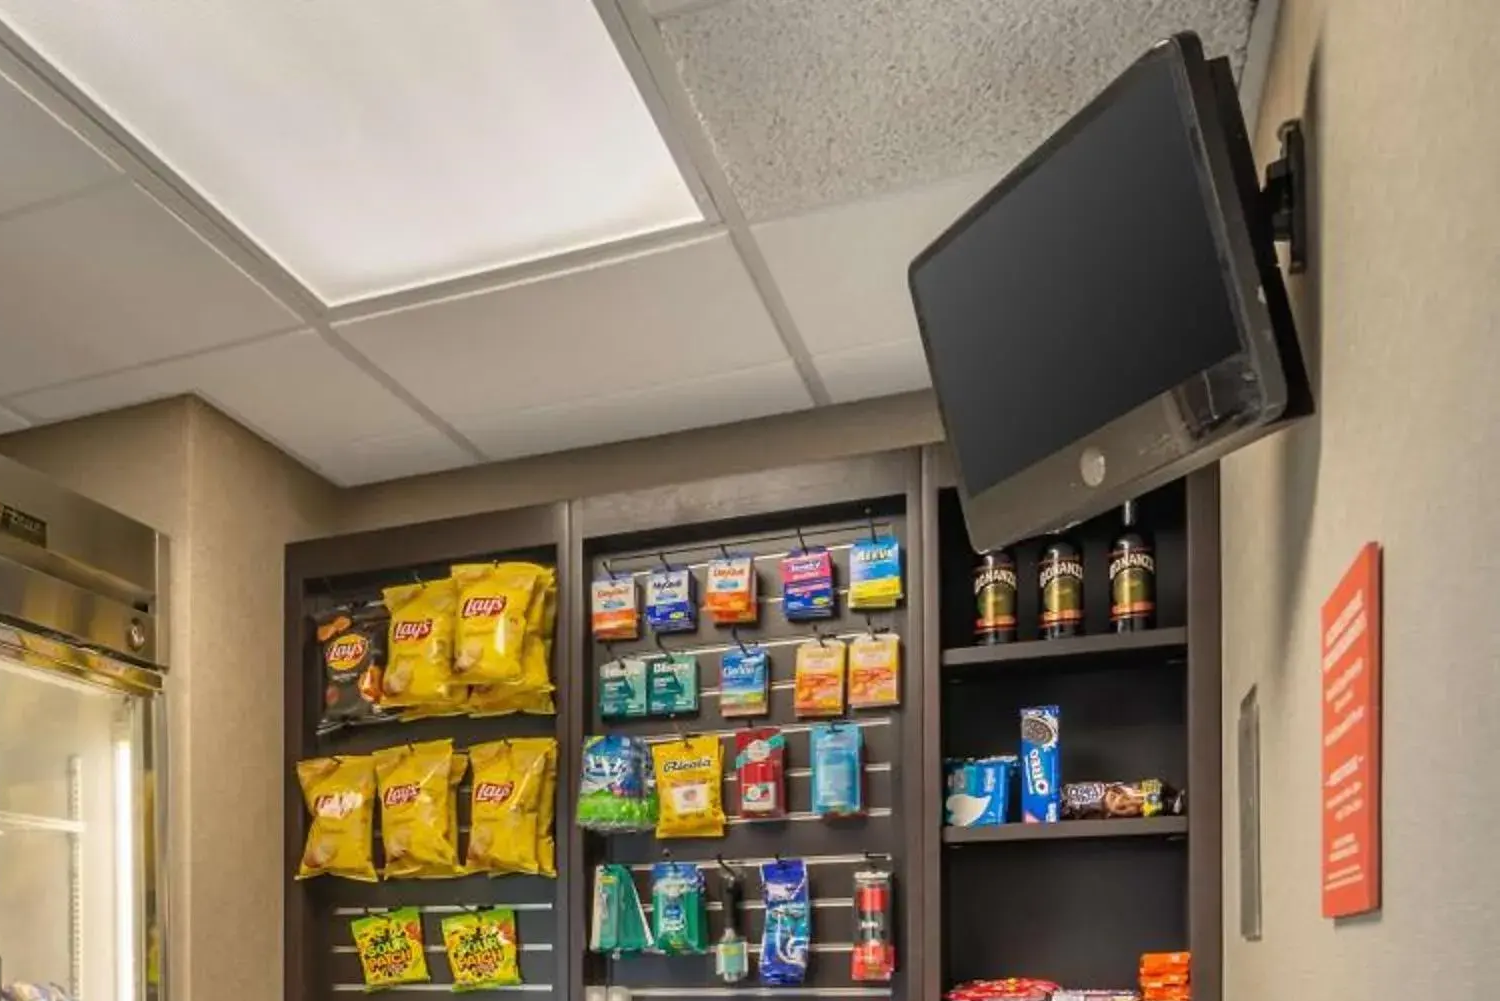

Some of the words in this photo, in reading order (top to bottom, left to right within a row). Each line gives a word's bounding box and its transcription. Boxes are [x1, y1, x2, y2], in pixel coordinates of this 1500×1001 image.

[459, 596, 507, 620] Lay's
[392, 618, 433, 643] Lay's
[325, 640, 367, 665] Lay's
[1026, 748, 1049, 795] OREO
